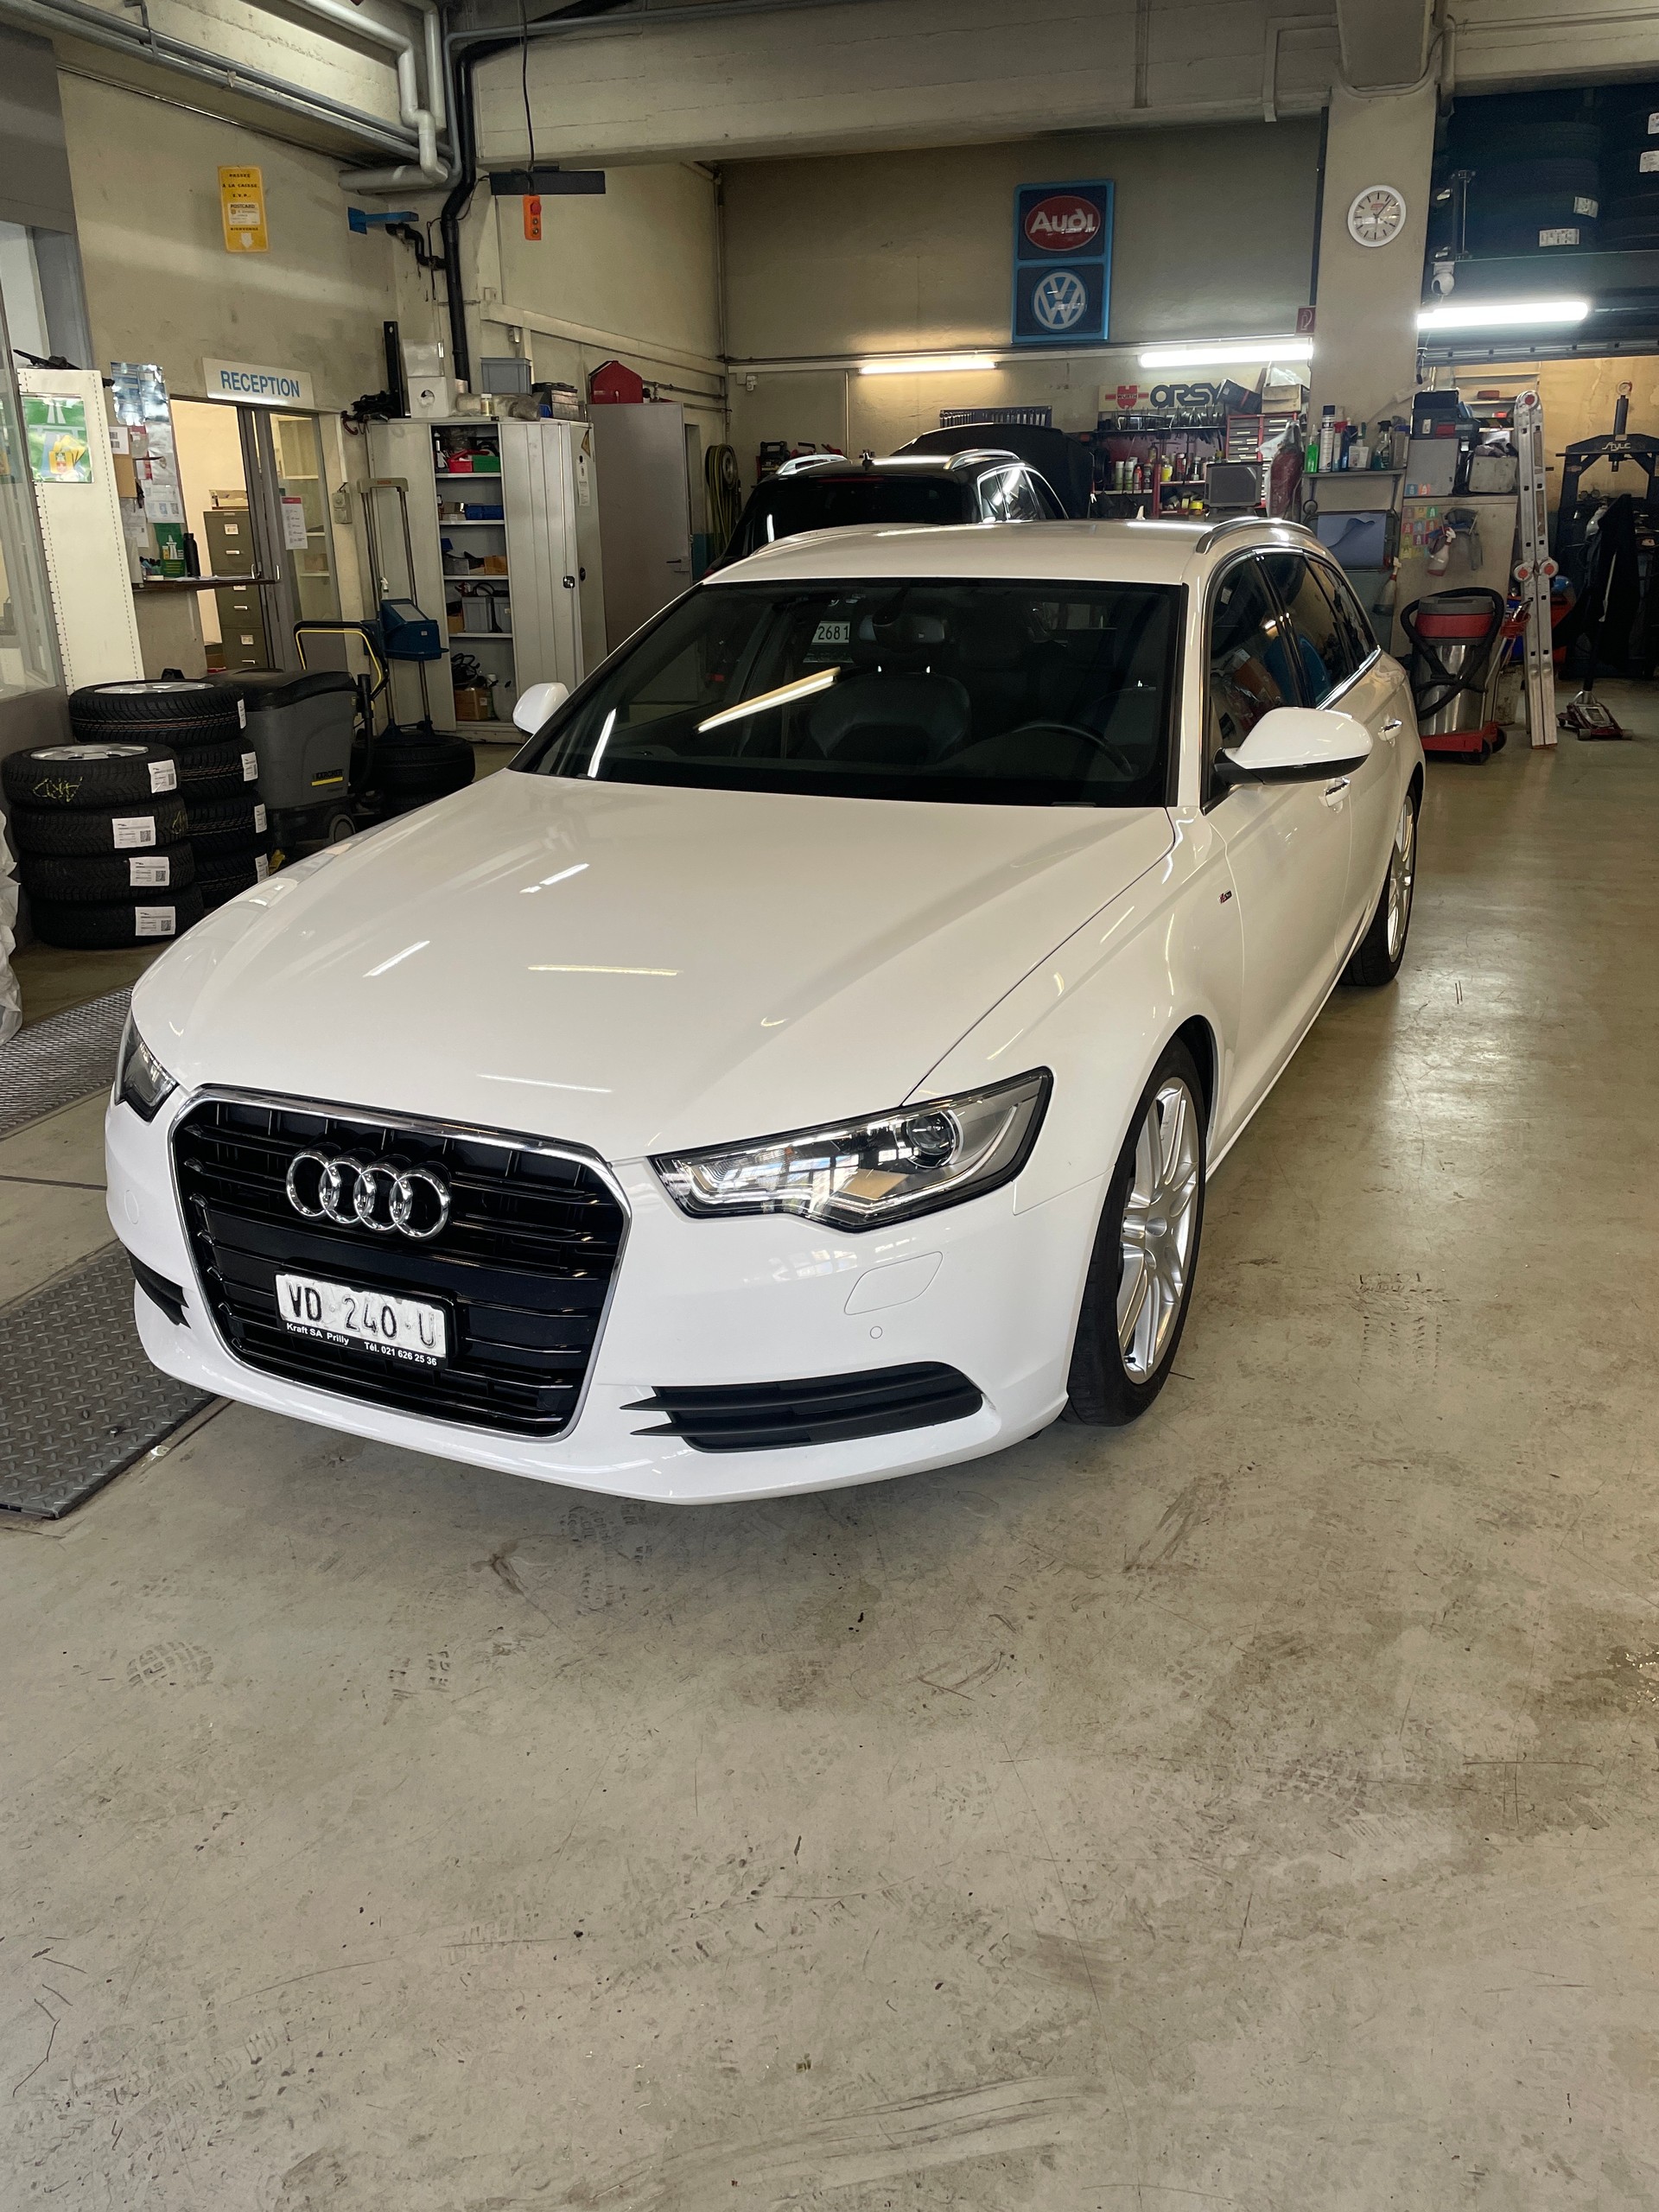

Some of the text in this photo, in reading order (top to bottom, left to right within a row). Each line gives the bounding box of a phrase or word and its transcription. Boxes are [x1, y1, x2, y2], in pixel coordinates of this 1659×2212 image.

[1029, 208, 1094, 234] Audi
[220, 370, 301, 397] RECEPTION
[1149, 383, 1222, 409] ORSY
[818, 626, 849, 640] 2681
[287, 1282, 322, 1322] VD
[344, 1297, 397, 1338] 240
[286, 1322, 437, 1366] Kraft SA Prilly Tél. 021 626 25 36
